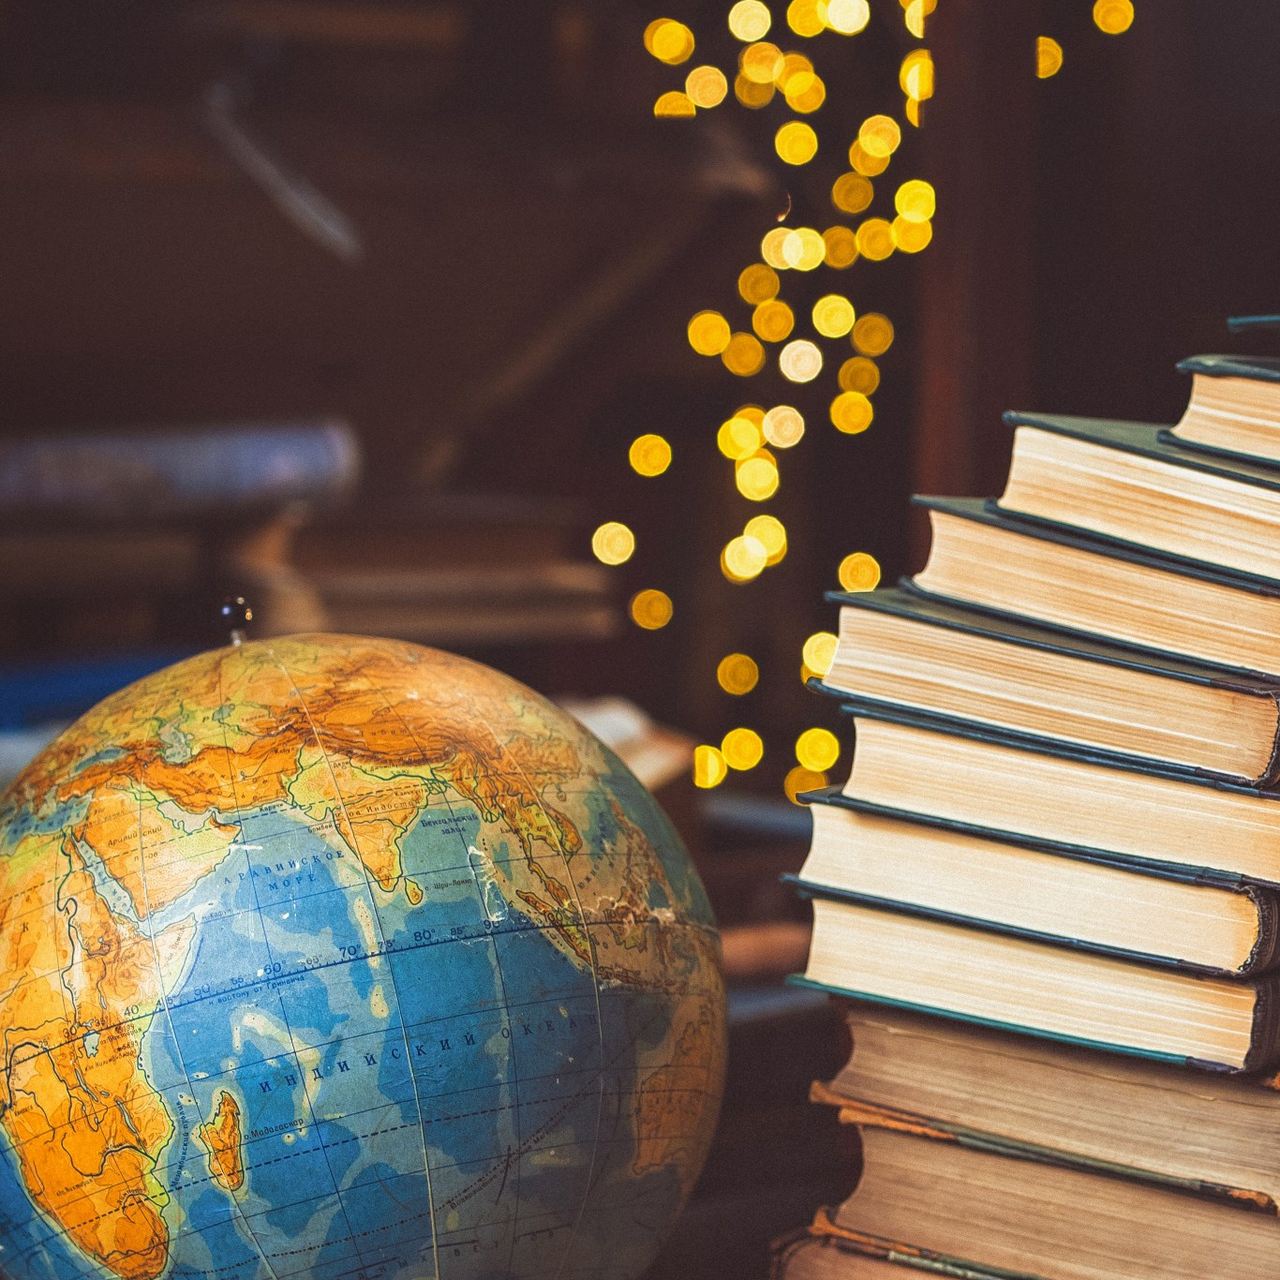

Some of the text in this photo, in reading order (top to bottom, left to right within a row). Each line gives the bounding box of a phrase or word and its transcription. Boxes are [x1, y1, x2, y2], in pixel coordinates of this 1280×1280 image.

[223, 849, 345, 885] АРАВИЙСКОЕ
[268, 873, 318, 892] МОРЕ
[413, 928, 436, 942] 80°
[339, 943, 363, 958] 70°
[501, 1014, 597, 1039] ОКЕАН
[258, 1032, 476, 1093] ИНДИЙСКИЙ
